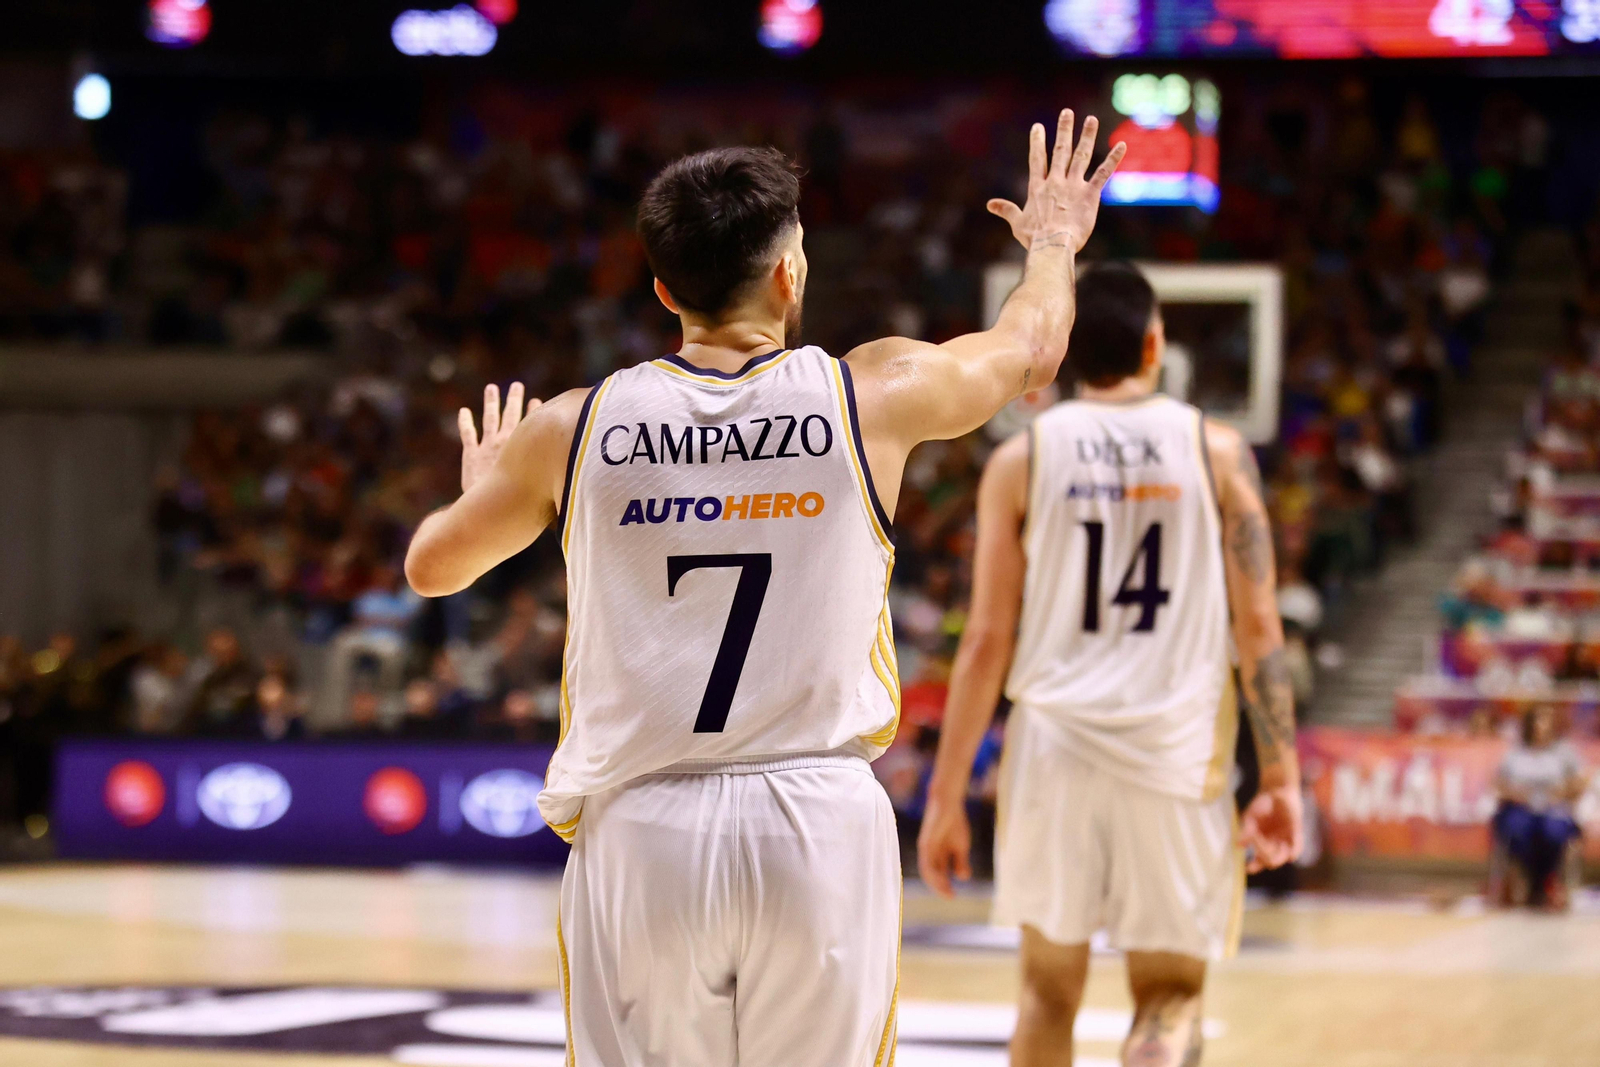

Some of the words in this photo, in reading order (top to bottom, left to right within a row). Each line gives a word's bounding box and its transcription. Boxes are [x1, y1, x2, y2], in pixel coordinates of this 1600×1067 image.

[600, 414, 833, 466] CAMPAZZO
[619, 491, 825, 526] AUTOHERO
[1080, 521, 1171, 633] 14
[666, 553, 772, 734] 7
